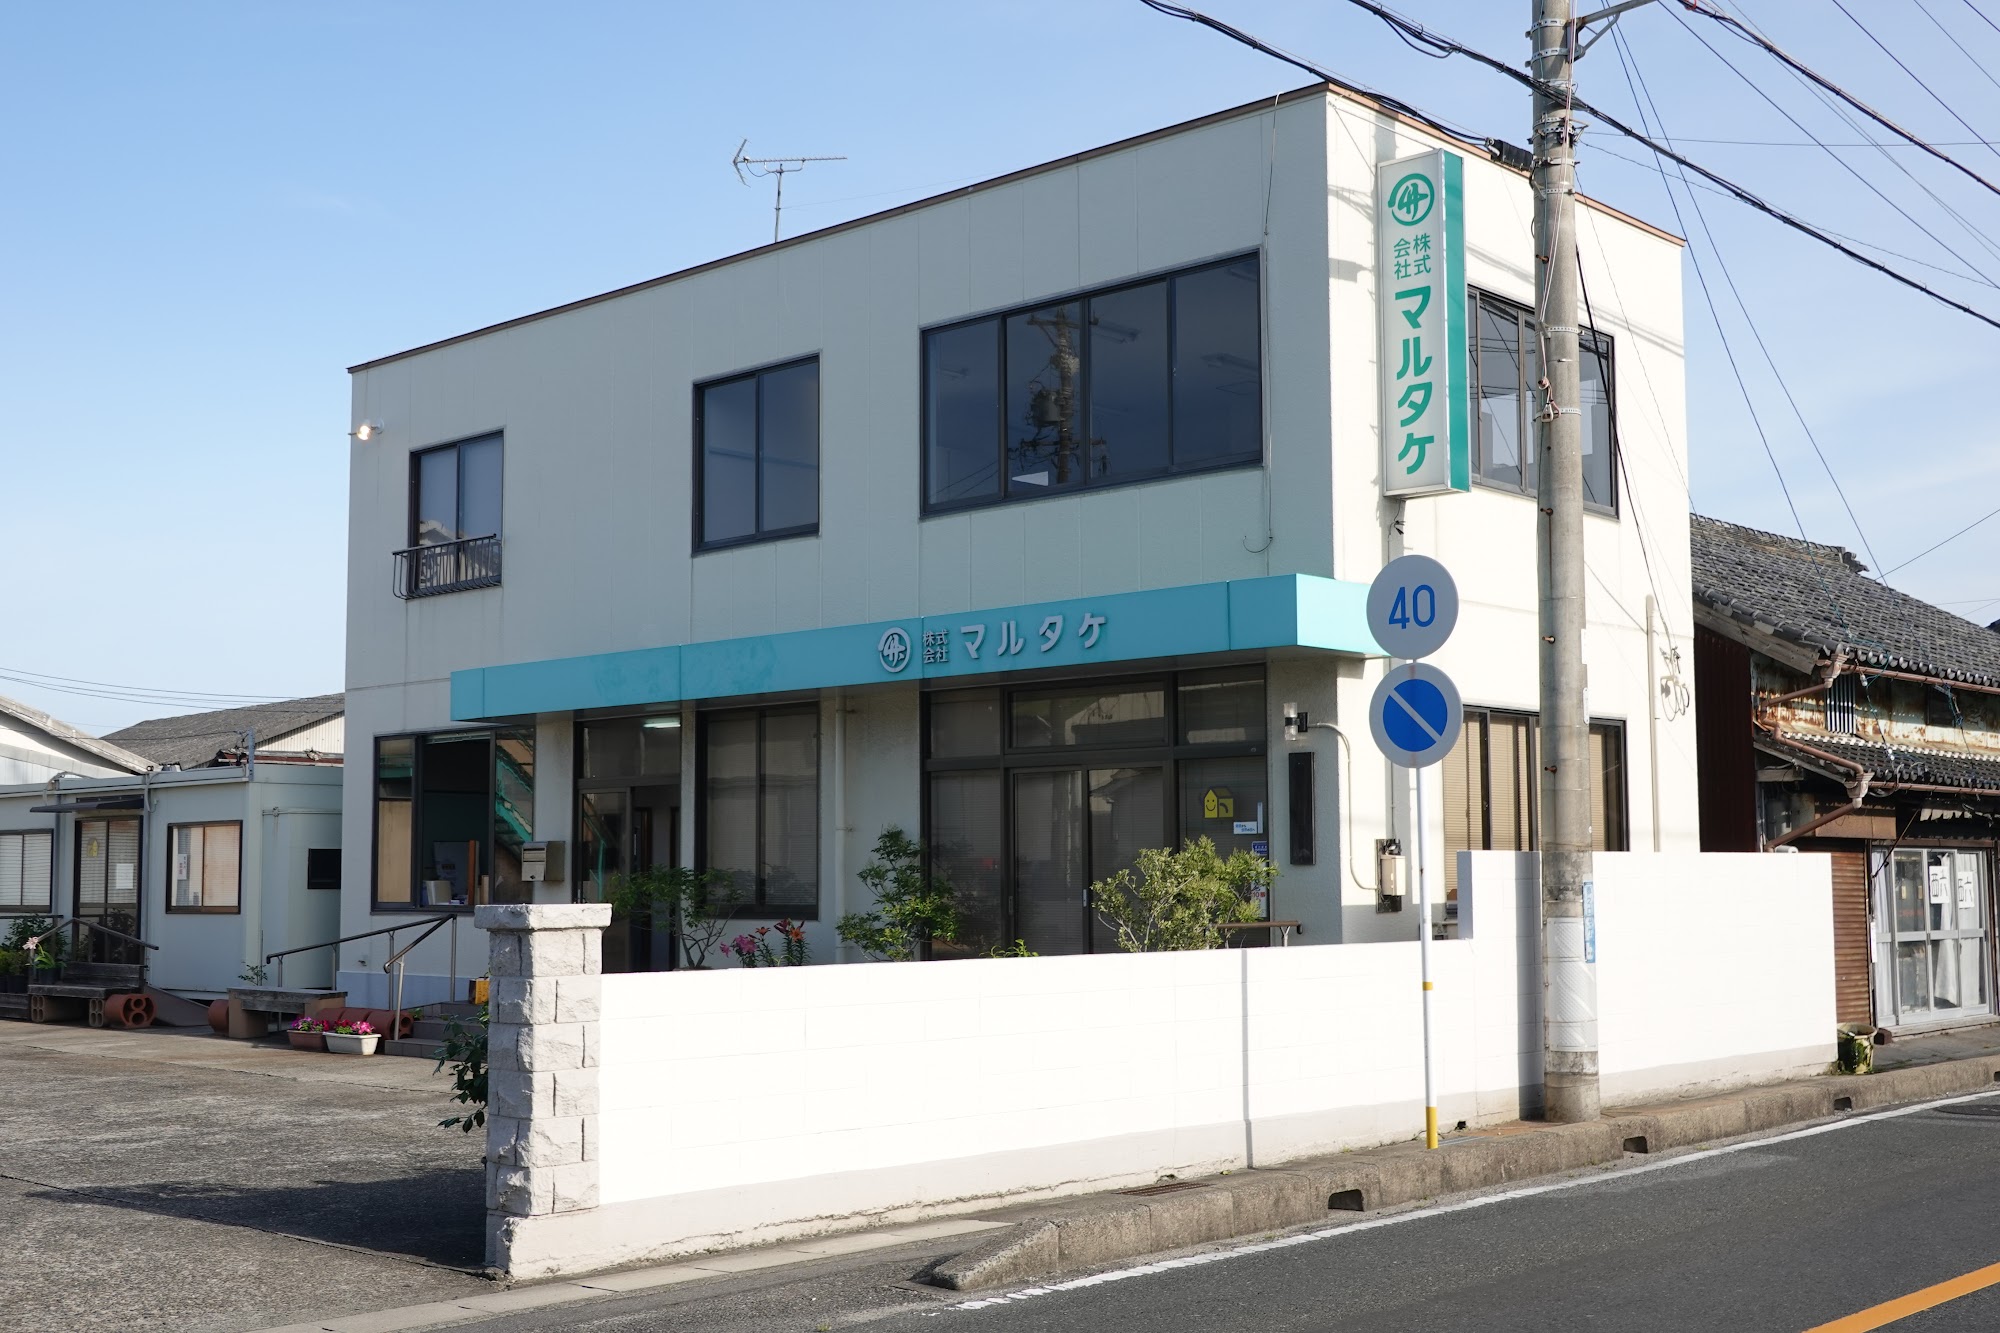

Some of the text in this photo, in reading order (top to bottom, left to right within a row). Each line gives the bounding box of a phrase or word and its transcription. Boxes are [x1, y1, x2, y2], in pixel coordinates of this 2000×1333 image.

[1395, 285, 1435, 475] マルタケ
[1388, 584, 1436, 629] 40
[960, 612, 1107, 659] マルタケ
